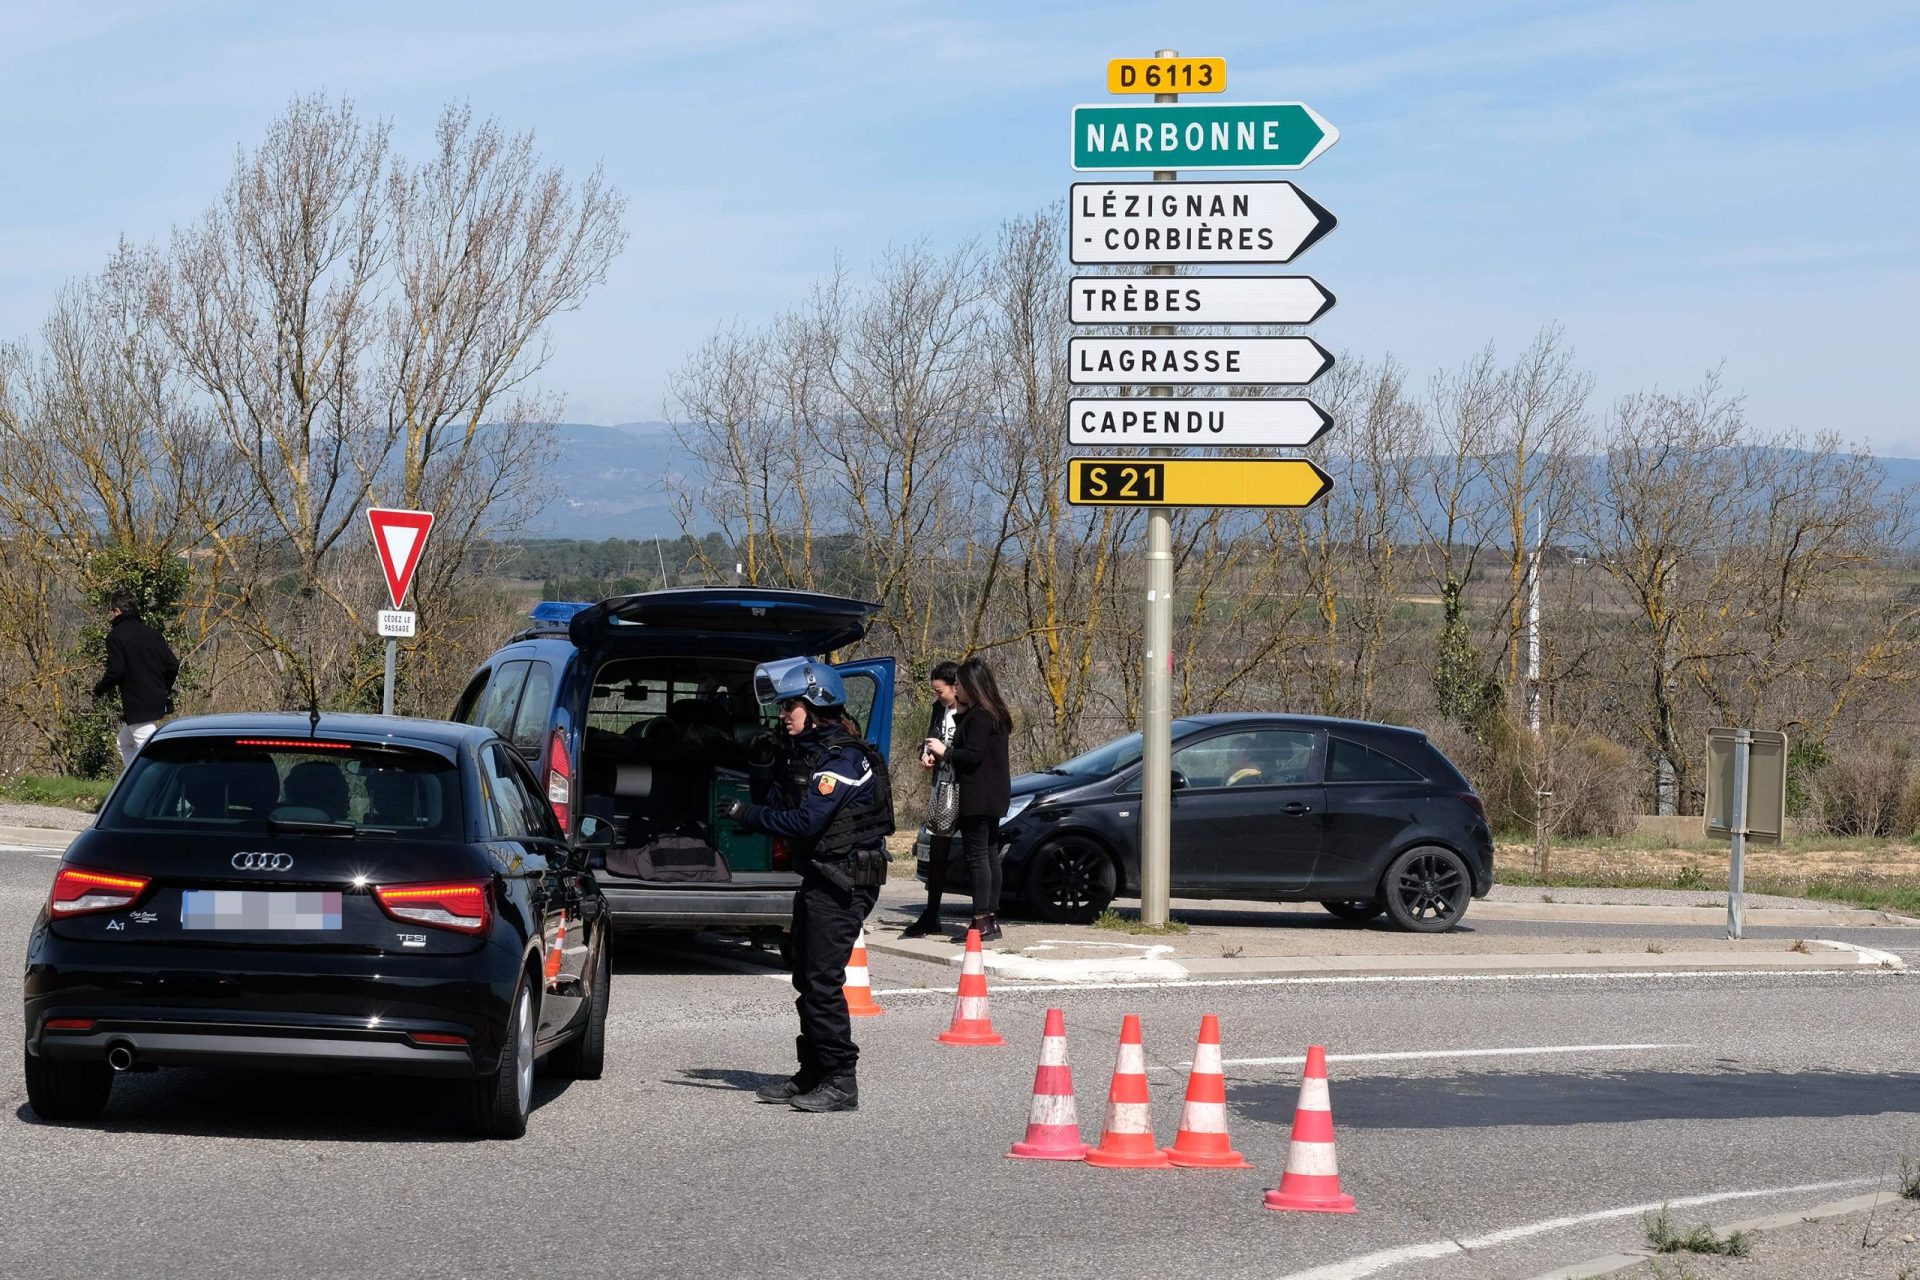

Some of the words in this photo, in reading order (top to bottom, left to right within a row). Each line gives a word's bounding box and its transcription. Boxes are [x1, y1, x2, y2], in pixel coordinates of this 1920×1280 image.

[1120, 65, 1136, 87] D
[1145, 64, 1213, 86] 6113
[1087, 121, 1280, 152] NARBONNE
[1082, 190, 1249, 218] LÉZIGNAN
[1082, 284, 1201, 312] TRÈBES
[1080, 349, 1241, 372] LAGRASSE
[1080, 411, 1225, 433] CAPENDU
[1089, 467, 1108, 497] S
[1119, 467, 1157, 497] 21
[384, 614, 402, 623] CÉDEZ
[385, 624, 409, 632] PASSAGE
[106, 919, 125, 931] A1
[396, 933, 426, 941] TFSI
